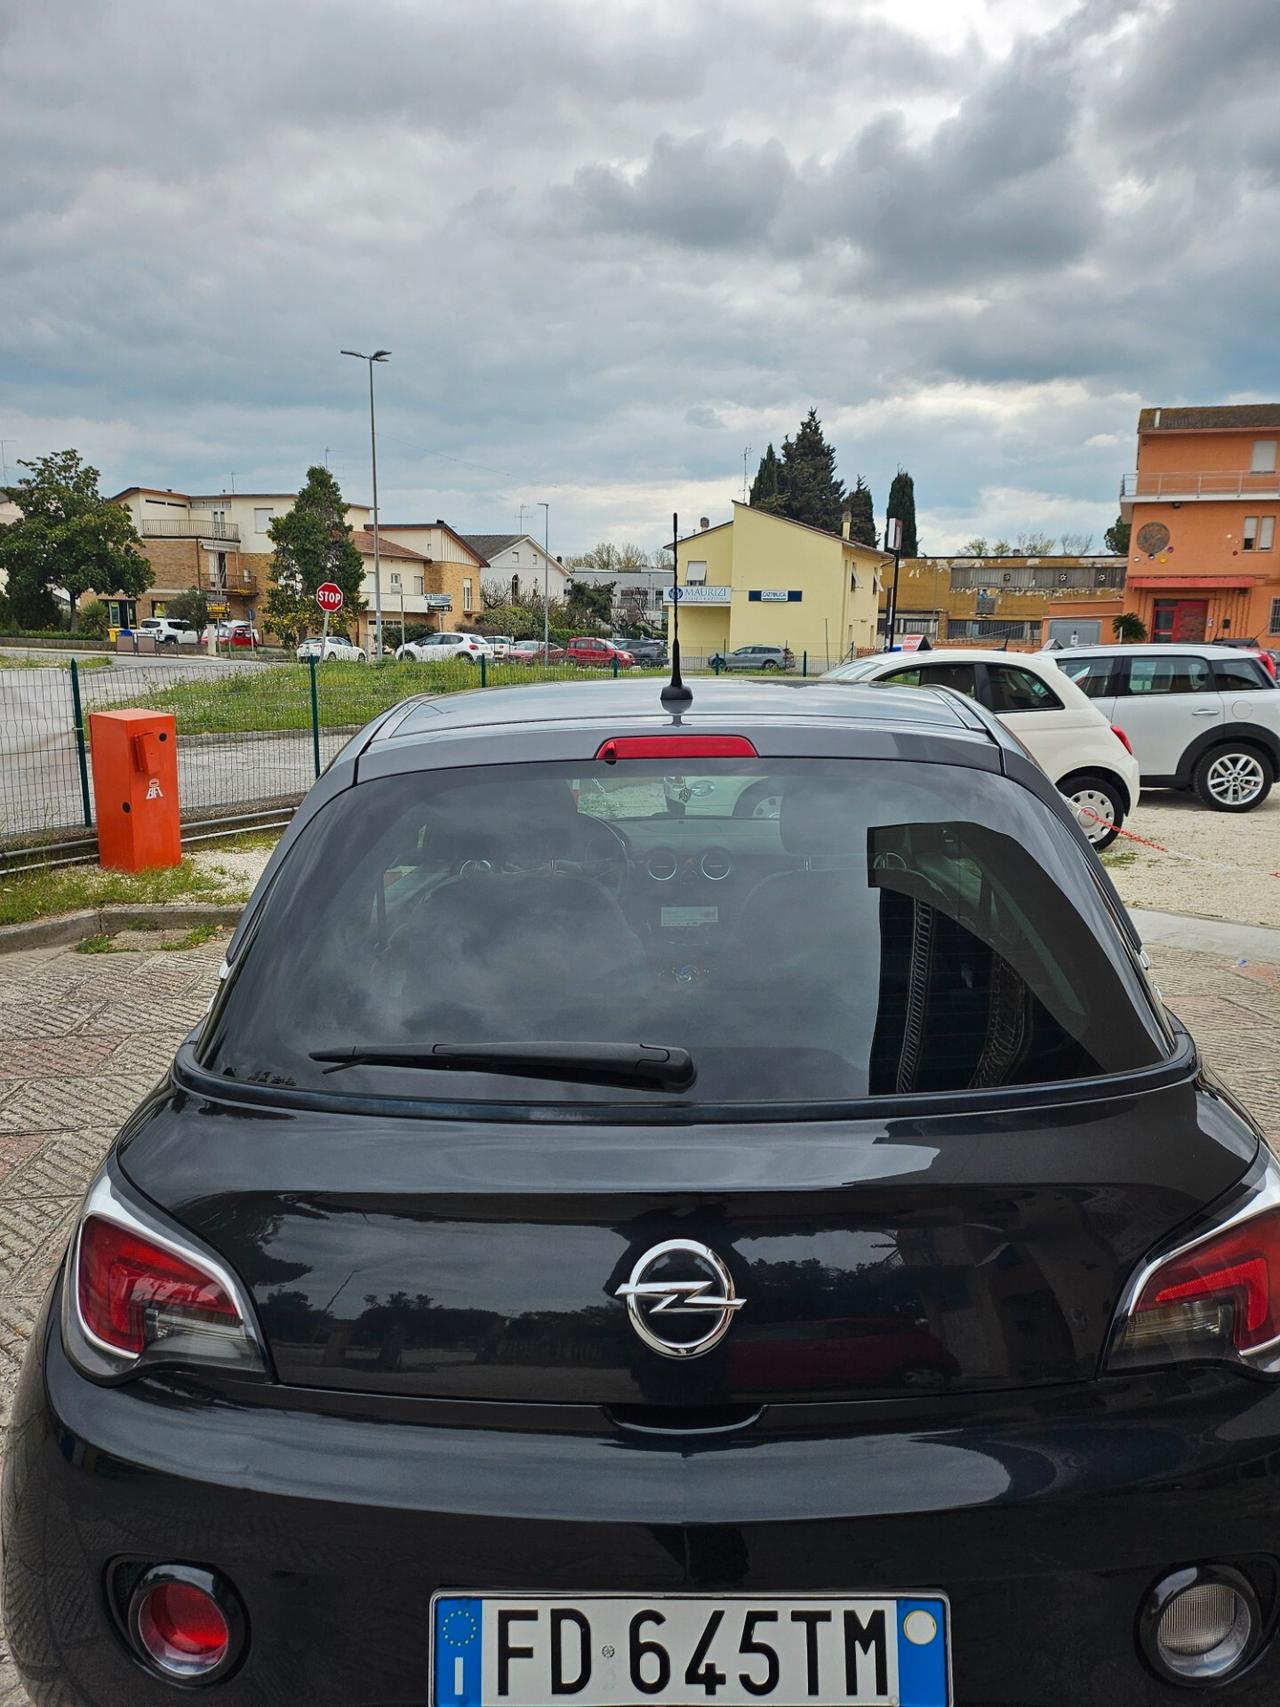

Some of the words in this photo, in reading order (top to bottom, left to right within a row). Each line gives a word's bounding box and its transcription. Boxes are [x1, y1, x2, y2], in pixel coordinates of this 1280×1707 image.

[318, 590, 341, 604] STOP
[685, 587, 726, 597] MAURIZI
[498, 1609, 592, 1695] FD
[629, 1609, 889, 1695] 645TM
